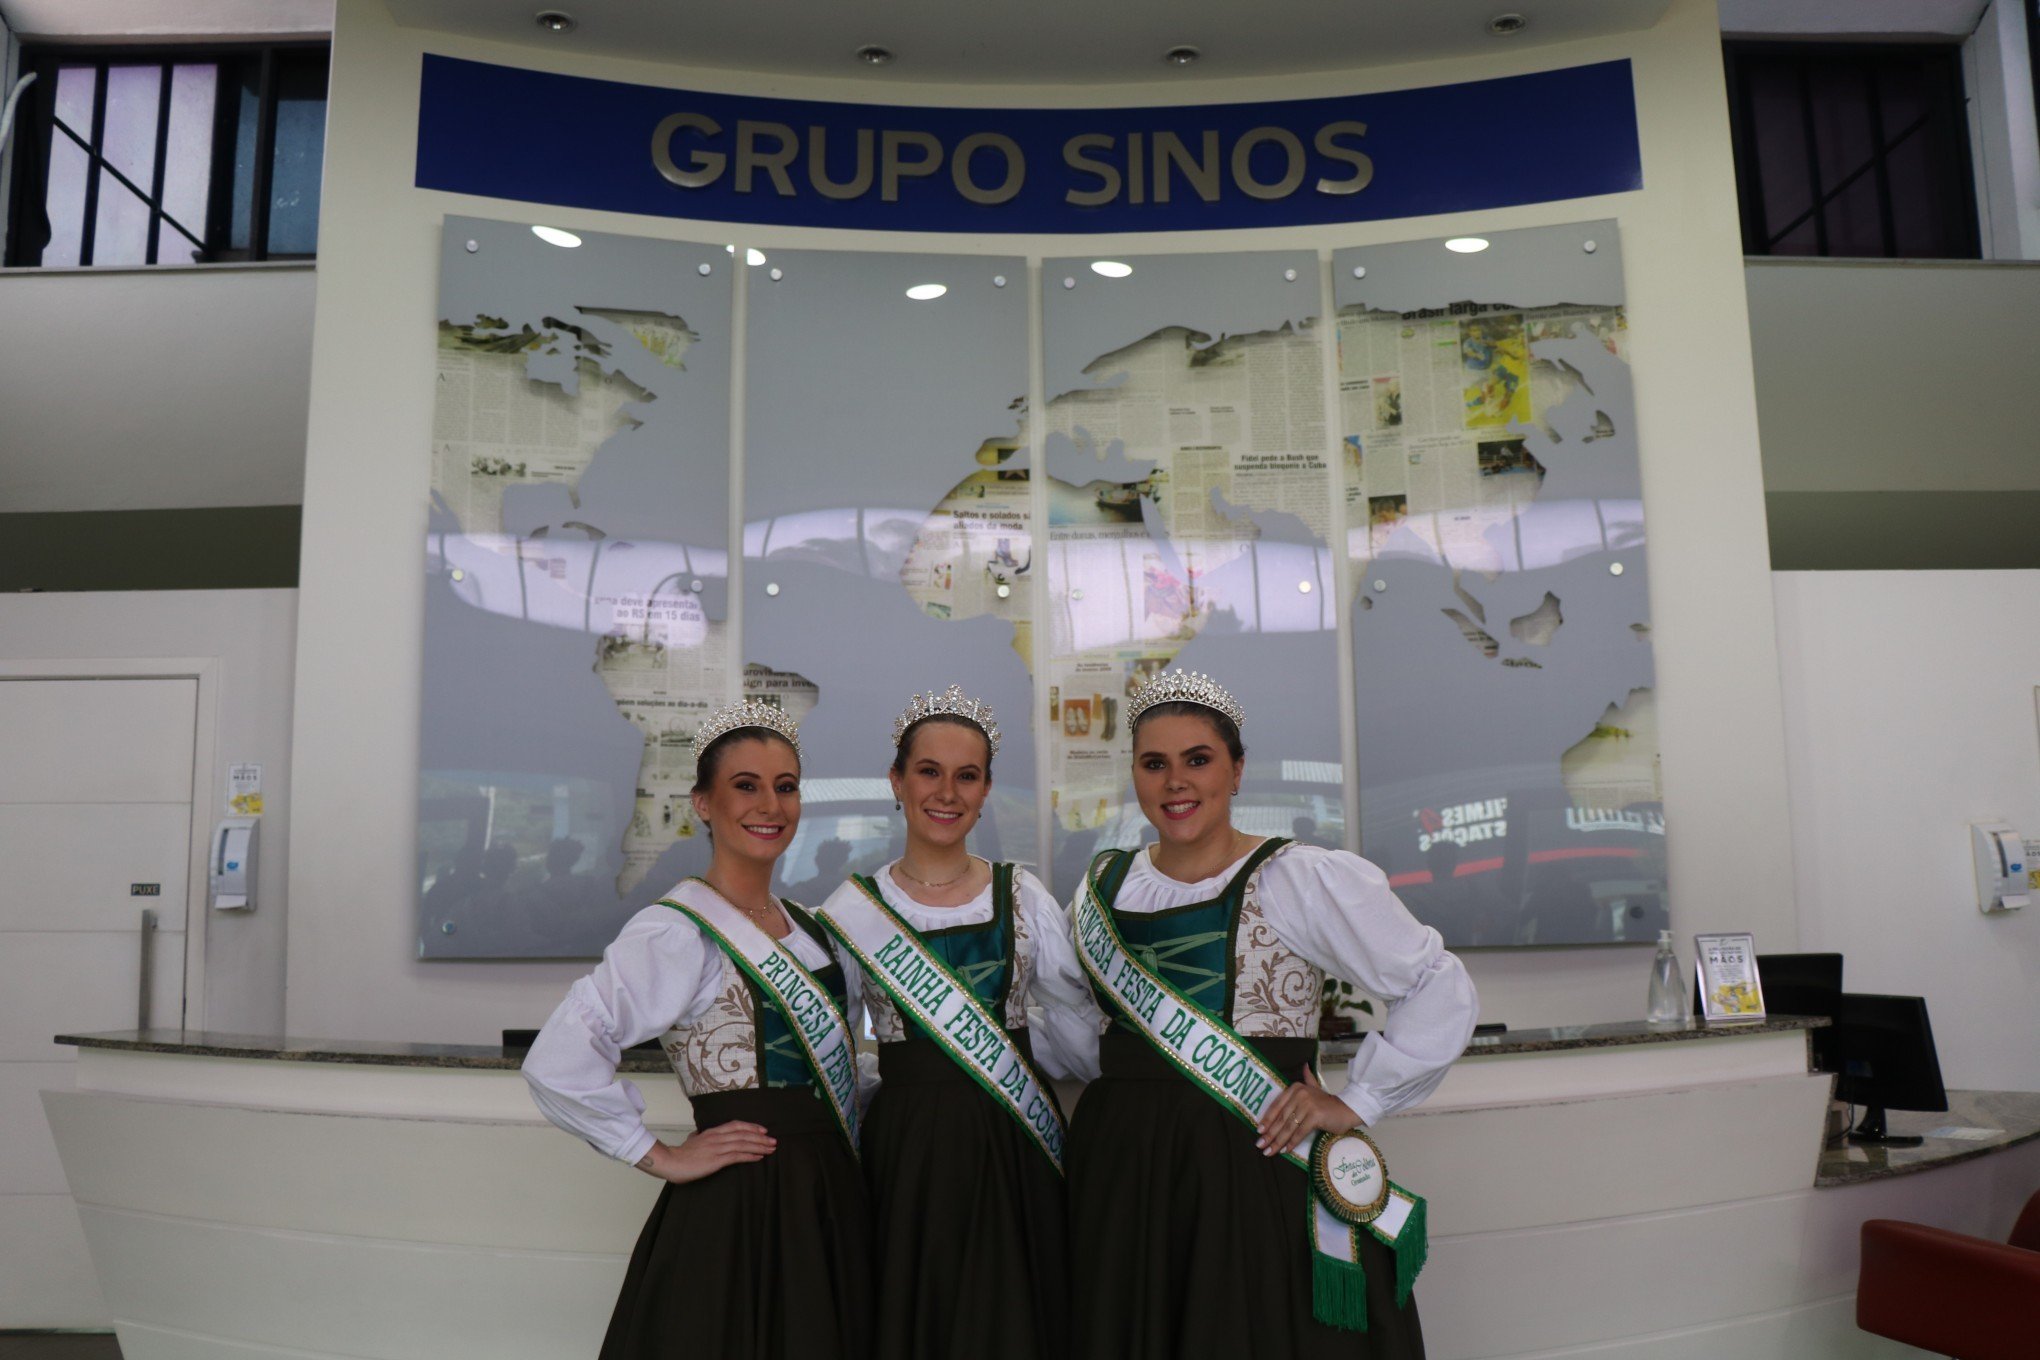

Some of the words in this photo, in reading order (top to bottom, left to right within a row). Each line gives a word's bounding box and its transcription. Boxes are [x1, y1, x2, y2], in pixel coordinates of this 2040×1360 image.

[651, 112, 1025, 205] GRUPO
[1062, 121, 1373, 206] SINOS
[1261, 455, 1278, 463] pede
[1306, 455, 1319, 463] que
[1234, 463, 1268, 471] suspenda
[1269, 463, 1300, 471] bloqueio
[953, 511, 979, 519] Saltos
[953, 521, 984, 530] aliados
[986, 522, 997, 530] da
[1000, 522, 1023, 530] moda
[620, 598, 643, 606] deve
[616, 609, 628, 618] ao
[632, 609, 644, 618] RS
[665, 611, 677, 620] 15
[680, 611, 700, 621] dias
[766, 680, 788, 689] para
[132, 885, 159, 895] PUXE
[1709, 953, 1743, 964] MÃOS
[1078, 890, 1117, 976] PRINCESA
[1112, 960, 1166, 1024] FESTA
[1160, 1008, 1197, 1051] DA
[1192, 1034, 1272, 1116] COLÔNIA
[873, 933, 954, 1017] RAINHA
[944, 1003, 1006, 1073] FESTA
[1000, 1061, 1030, 1103] DA
[758, 951, 836, 1050] PRINCESA
[820, 1040, 855, 1109] FESTA
